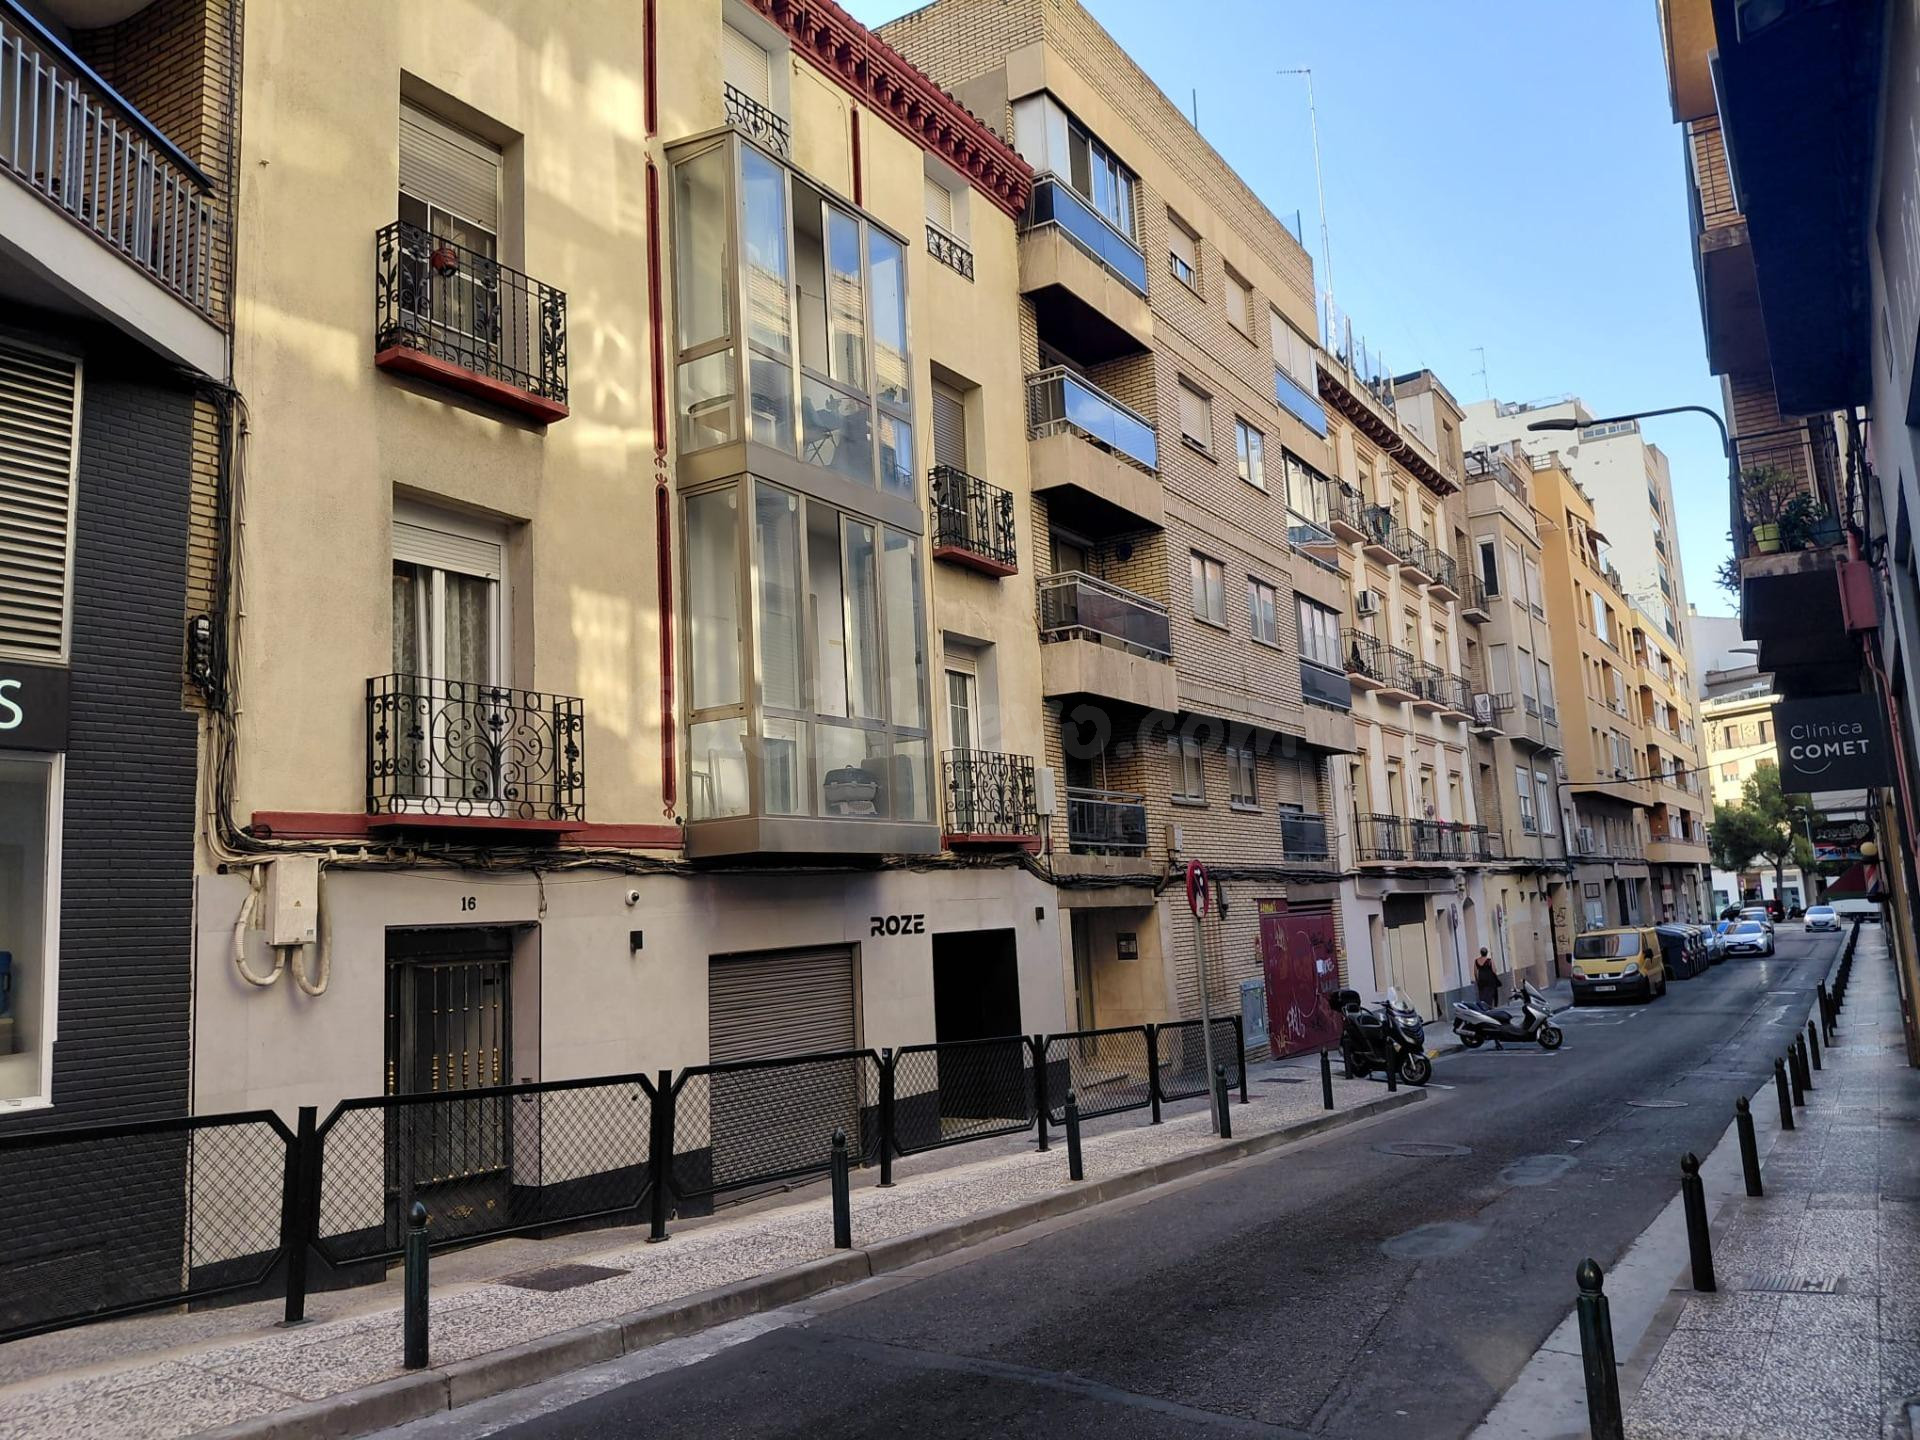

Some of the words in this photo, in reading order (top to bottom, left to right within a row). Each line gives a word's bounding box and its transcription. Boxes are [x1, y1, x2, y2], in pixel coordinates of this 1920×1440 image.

[1790, 721, 1863, 740] Clínica
[1790, 739, 1869, 760] COMET
[461, 896, 477, 912] 16
[870, 914, 925, 937] ROZE
